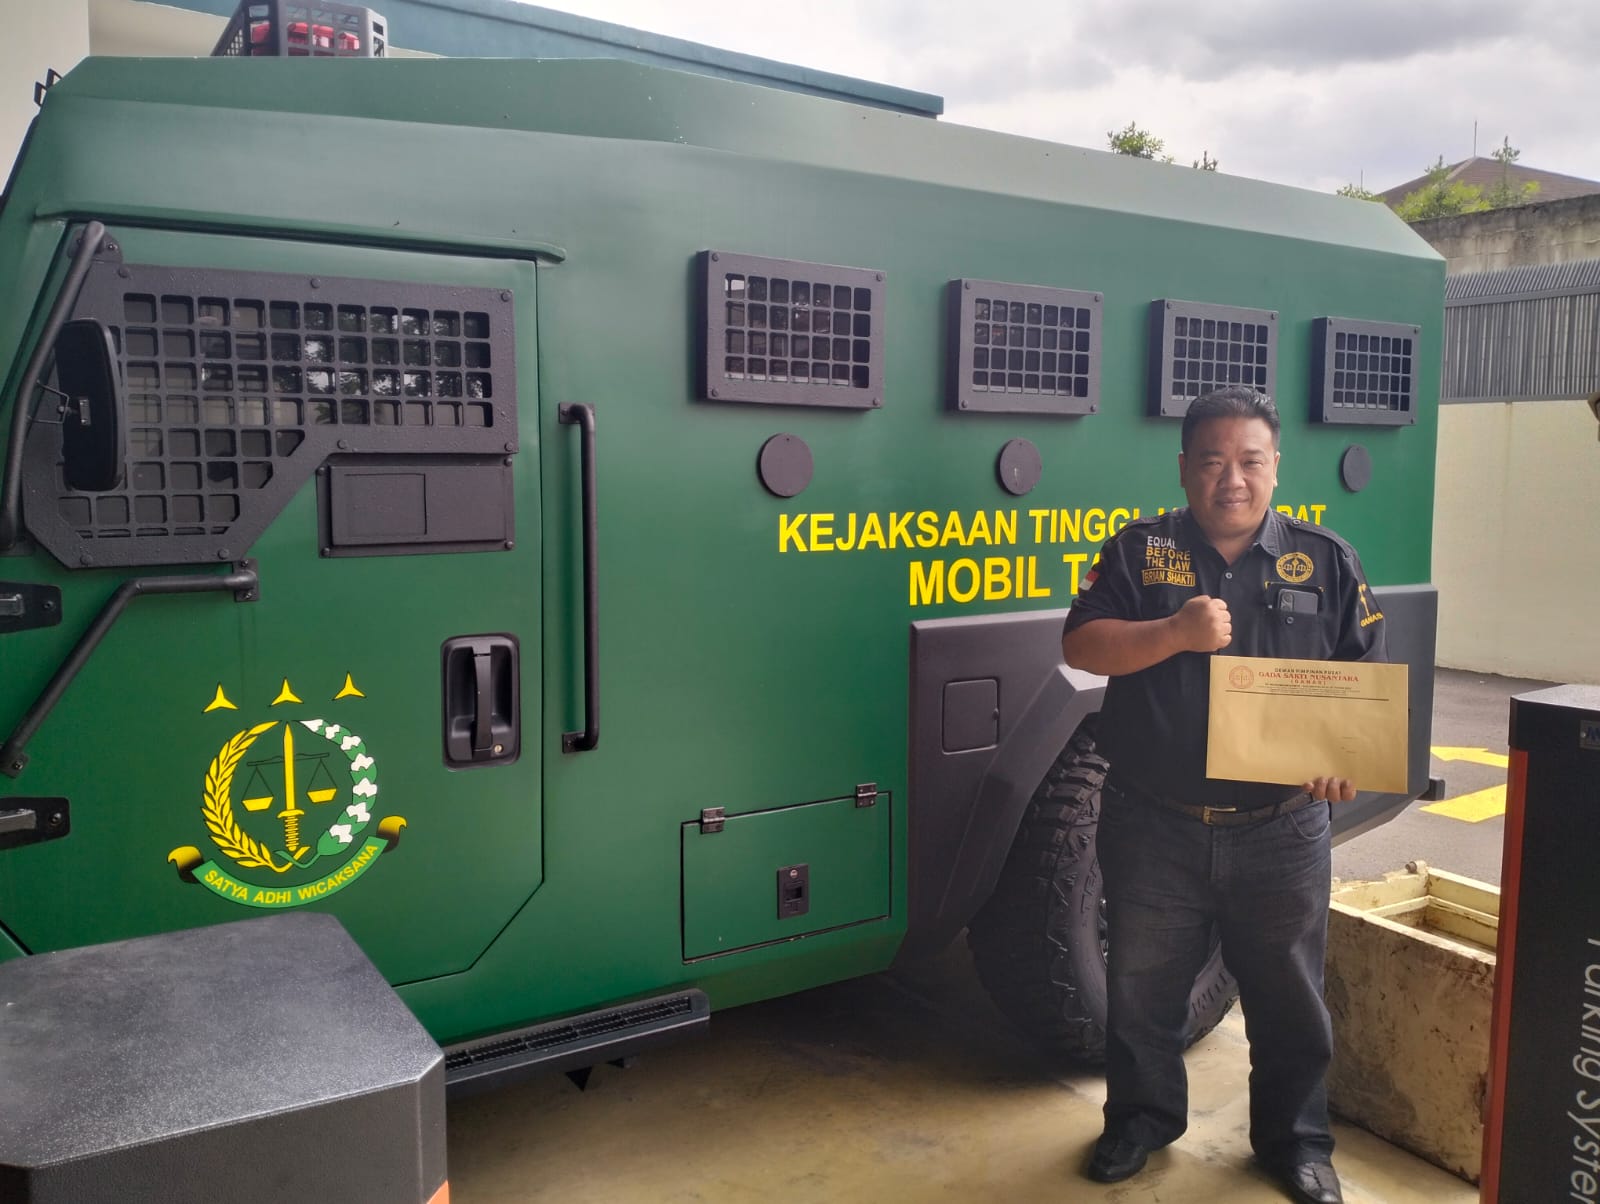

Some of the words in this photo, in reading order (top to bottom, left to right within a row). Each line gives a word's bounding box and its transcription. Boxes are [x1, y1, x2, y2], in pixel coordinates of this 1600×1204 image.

[779, 510, 1017, 552] KEJAKSAAN
[1147, 535, 1176, 549] EQUAL
[1145, 556, 1165, 568] THE
[1169, 559, 1191, 571] LAW
[1146, 546, 1191, 561] BEFORE
[909, 556, 1051, 606] MOBIL
[1063, 552, 1100, 596] T
[1166, 571, 1193, 585] SHAKTI
[1259, 671, 1281, 679] GADA
[1310, 674, 1360, 682] NUSANTARA
[204, 870, 248, 900] SATYA
[253, 890, 292, 904] ADHI
[297, 844, 379, 901] WICAKSANA
[1572, 938, 1600, 1081] arking
[1567, 1089, 1600, 1204] Syste
